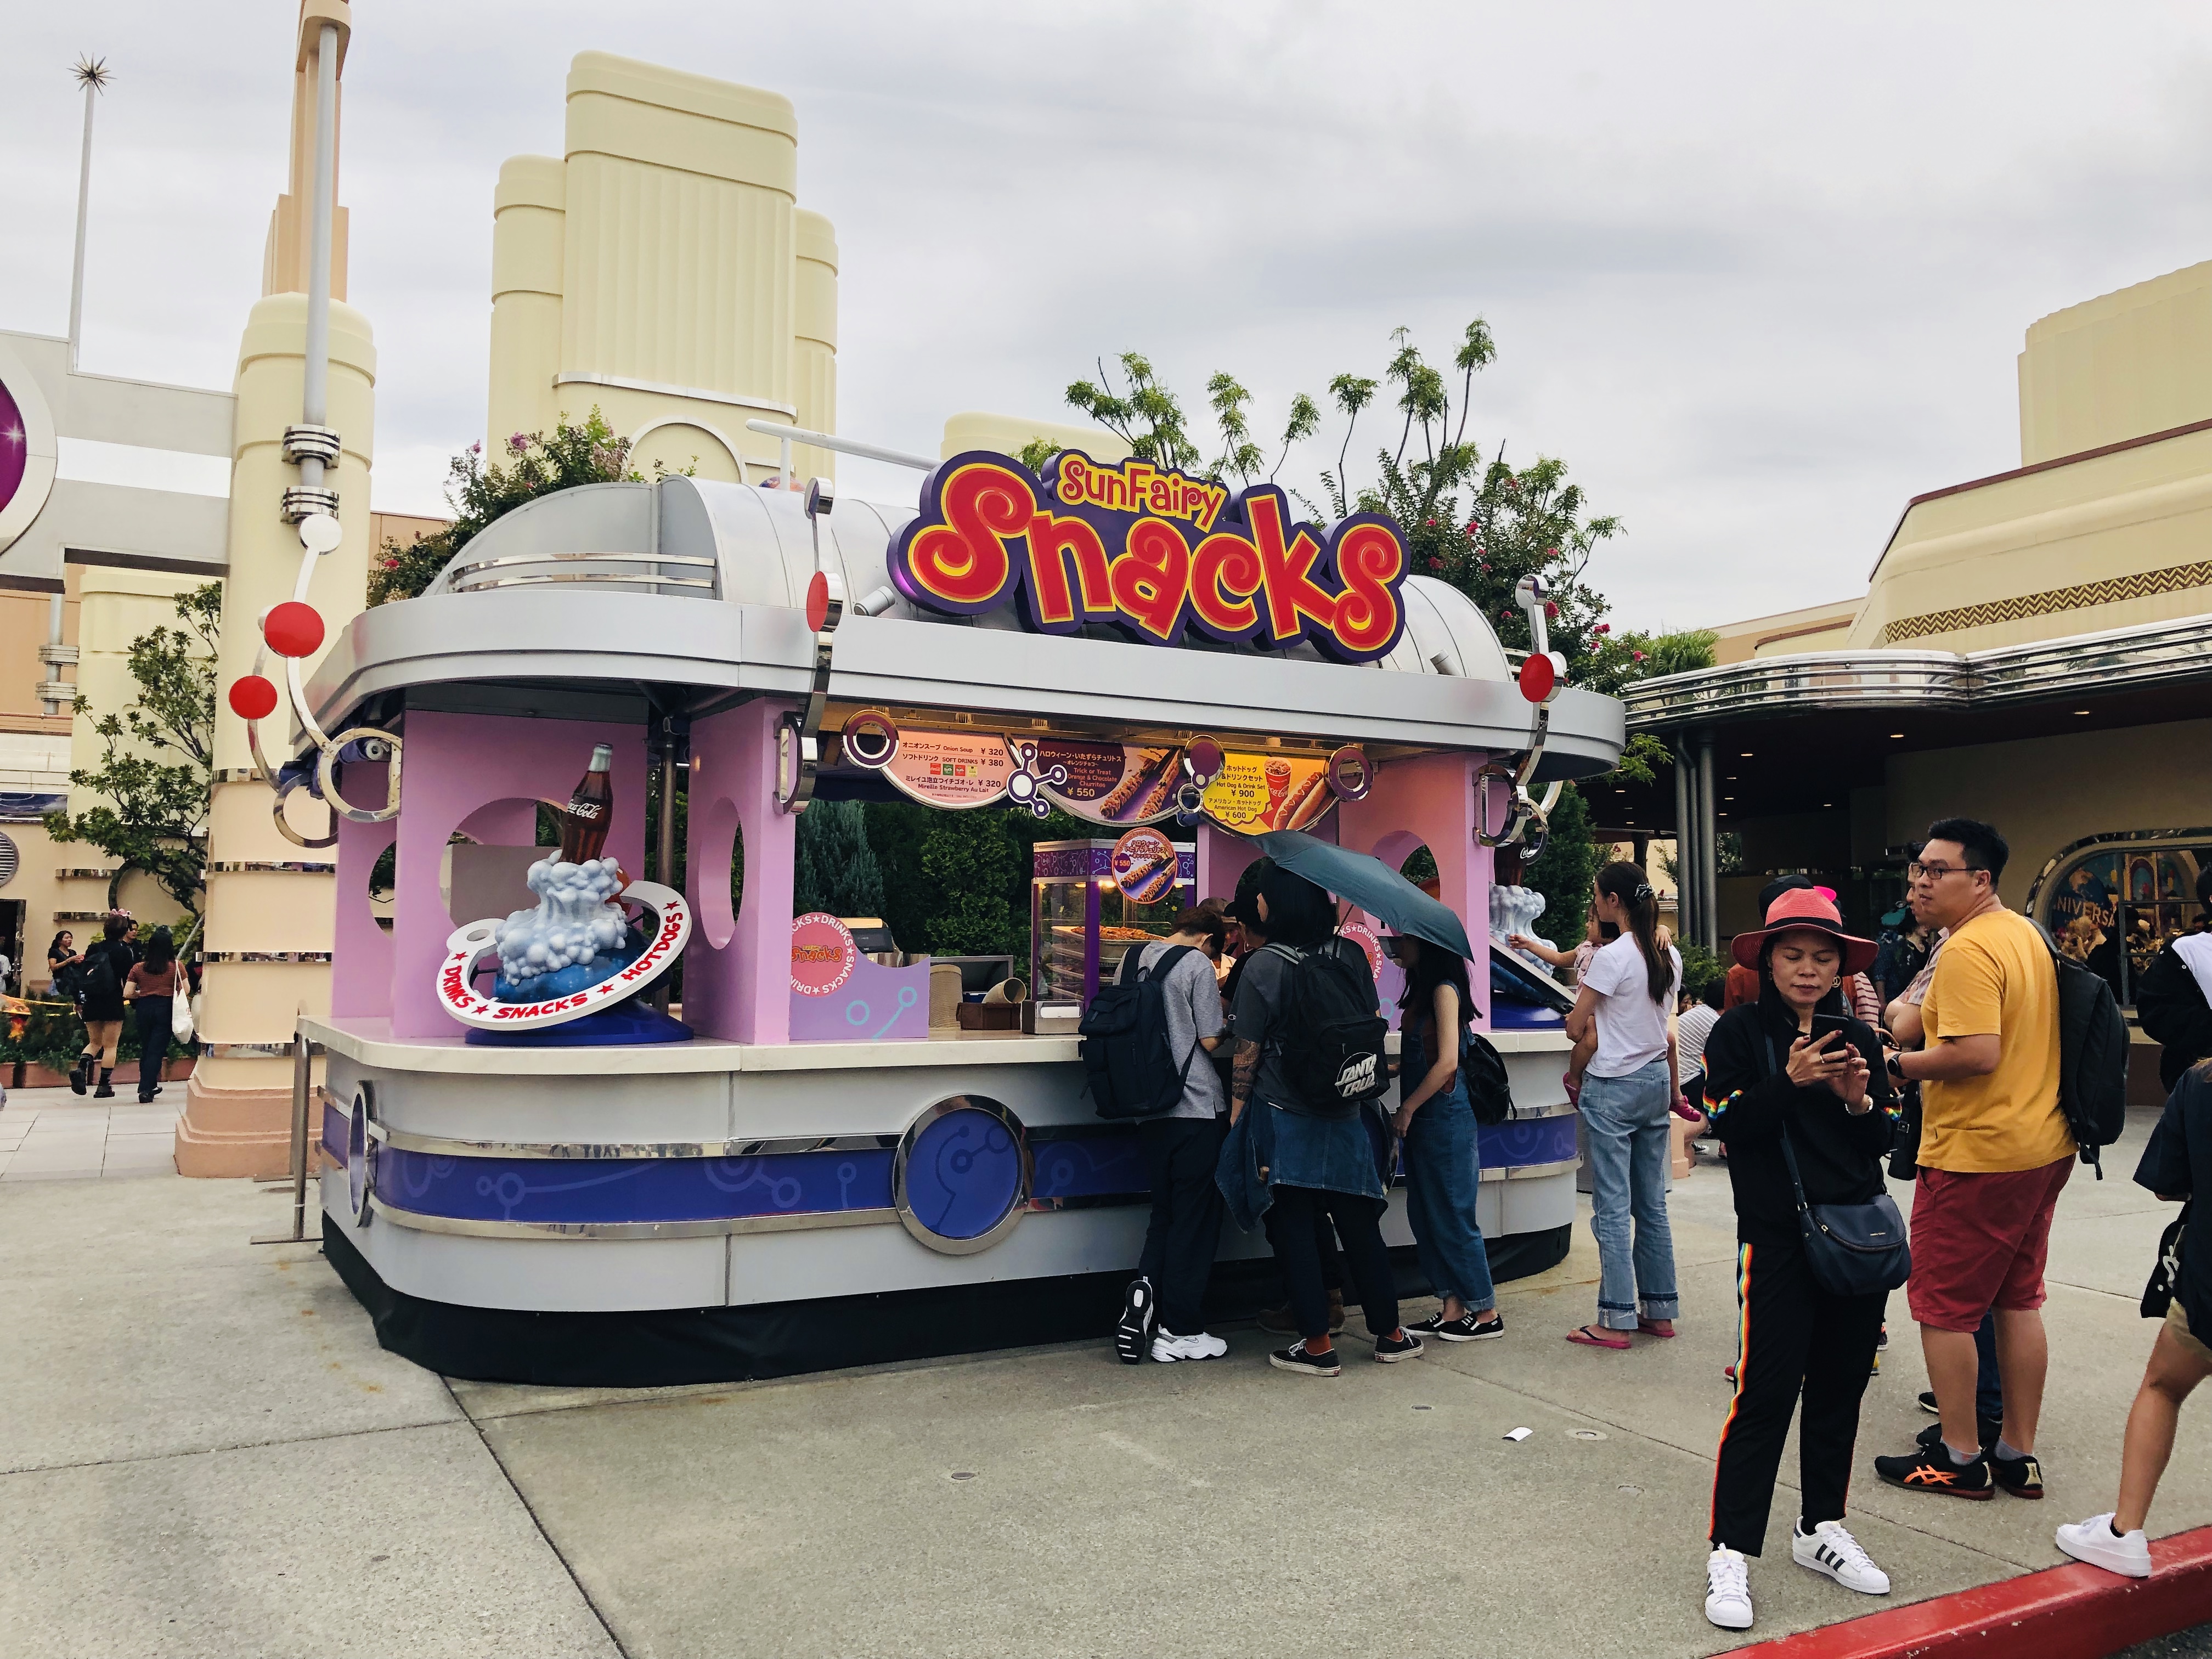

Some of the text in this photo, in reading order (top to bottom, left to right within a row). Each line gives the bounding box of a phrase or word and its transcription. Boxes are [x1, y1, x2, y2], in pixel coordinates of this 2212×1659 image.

[1057, 454, 1227, 533] SunFairy
[909, 463, 1403, 652] Snacks
[902, 742, 941, 751] オニオンスープ
[902, 753, 939, 761] ソフトドリンク
[1226, 764, 1257, 773] ホットドッグ
[1067, 787, 1095, 797] ¥ 550
[1239, 789, 1255, 798] 900
[821, 915, 854, 946] DRINKS
[1357, 924, 1381, 952] DRINKS
[792, 945, 843, 963] Snacks
[822, 955, 855, 994] SNACKS
[443, 964, 476, 1008] DRINKS
[492, 993, 588, 1019] SNACKS
